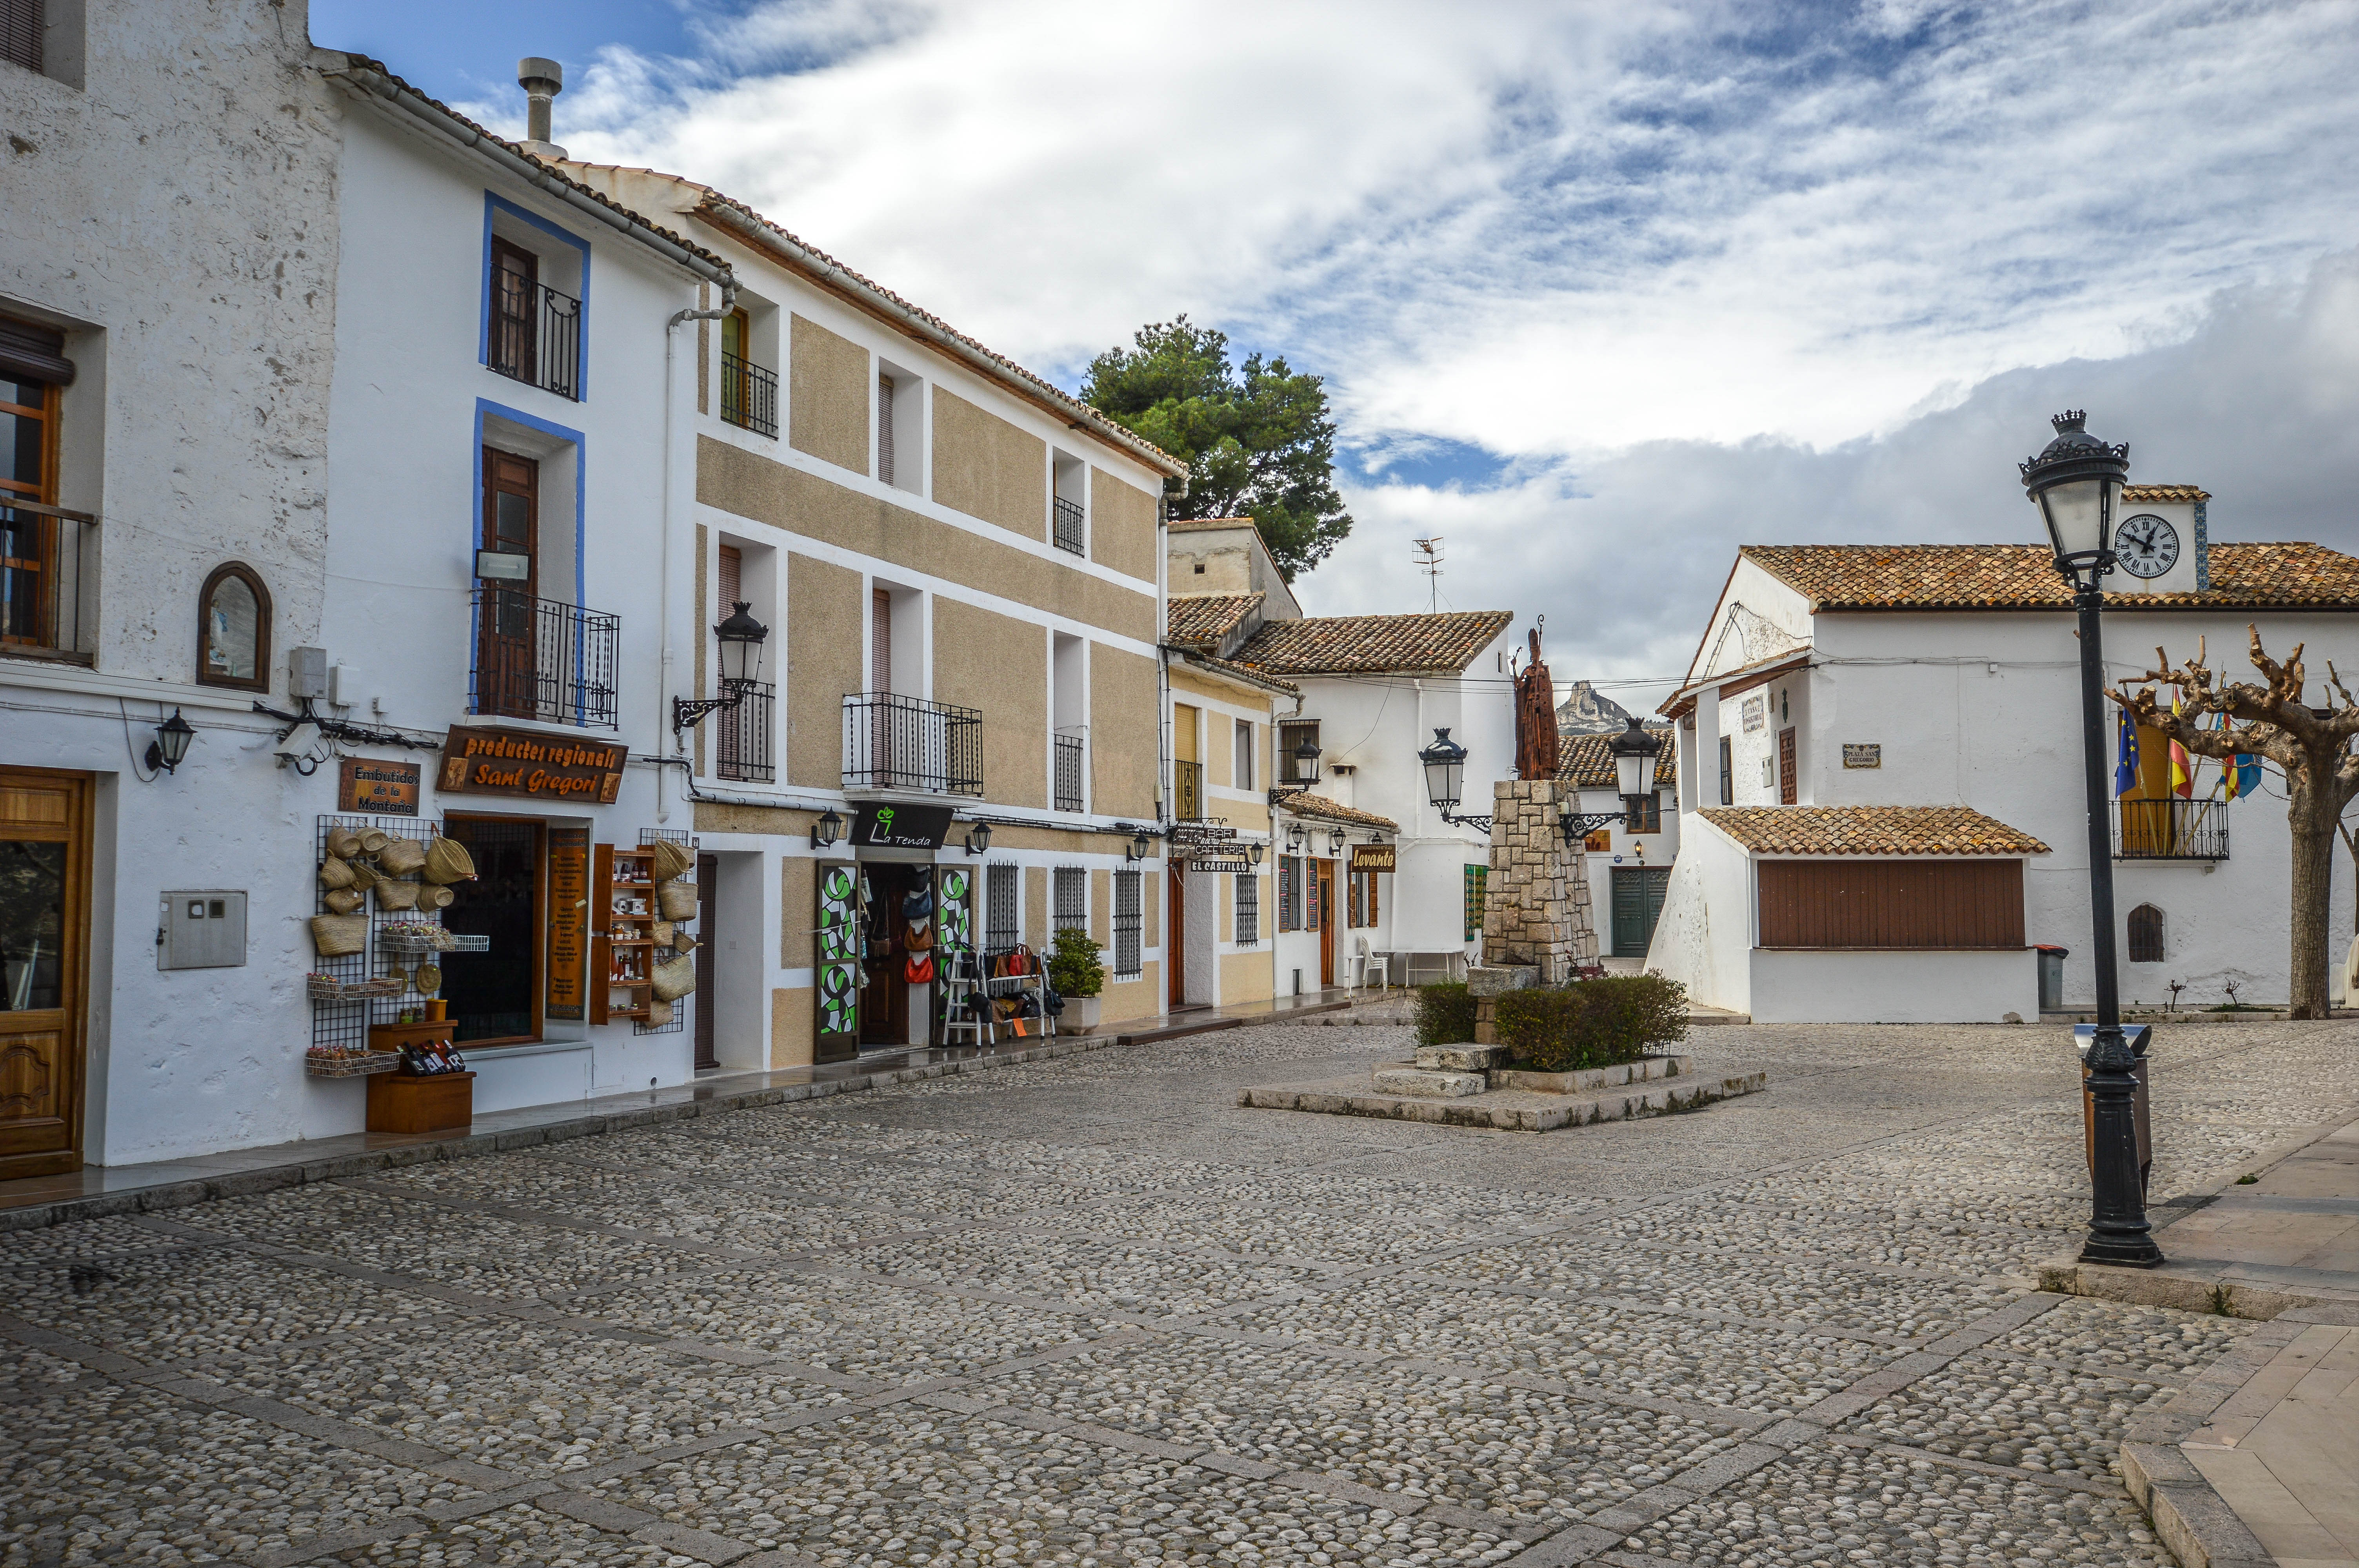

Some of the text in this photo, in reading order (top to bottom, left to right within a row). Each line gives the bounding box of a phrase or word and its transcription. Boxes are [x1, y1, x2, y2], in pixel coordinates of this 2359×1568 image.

[2131, 524, 2139, 534] XI
[465, 736, 616, 769] productes regionals
[354, 766, 420, 786] Embutidos
[474, 764, 598, 795] Sant Gregori
[374, 784, 400, 797] de la
[358, 796, 413, 815] Montaña
[870, 823, 931, 846] La Tenda
[1207, 829, 1232, 838] BAR
[1196, 846, 1244, 855] CAFETERIA
[1354, 849, 1393, 866] Levante
[1205, 862, 1247, 871] CASTILLO
